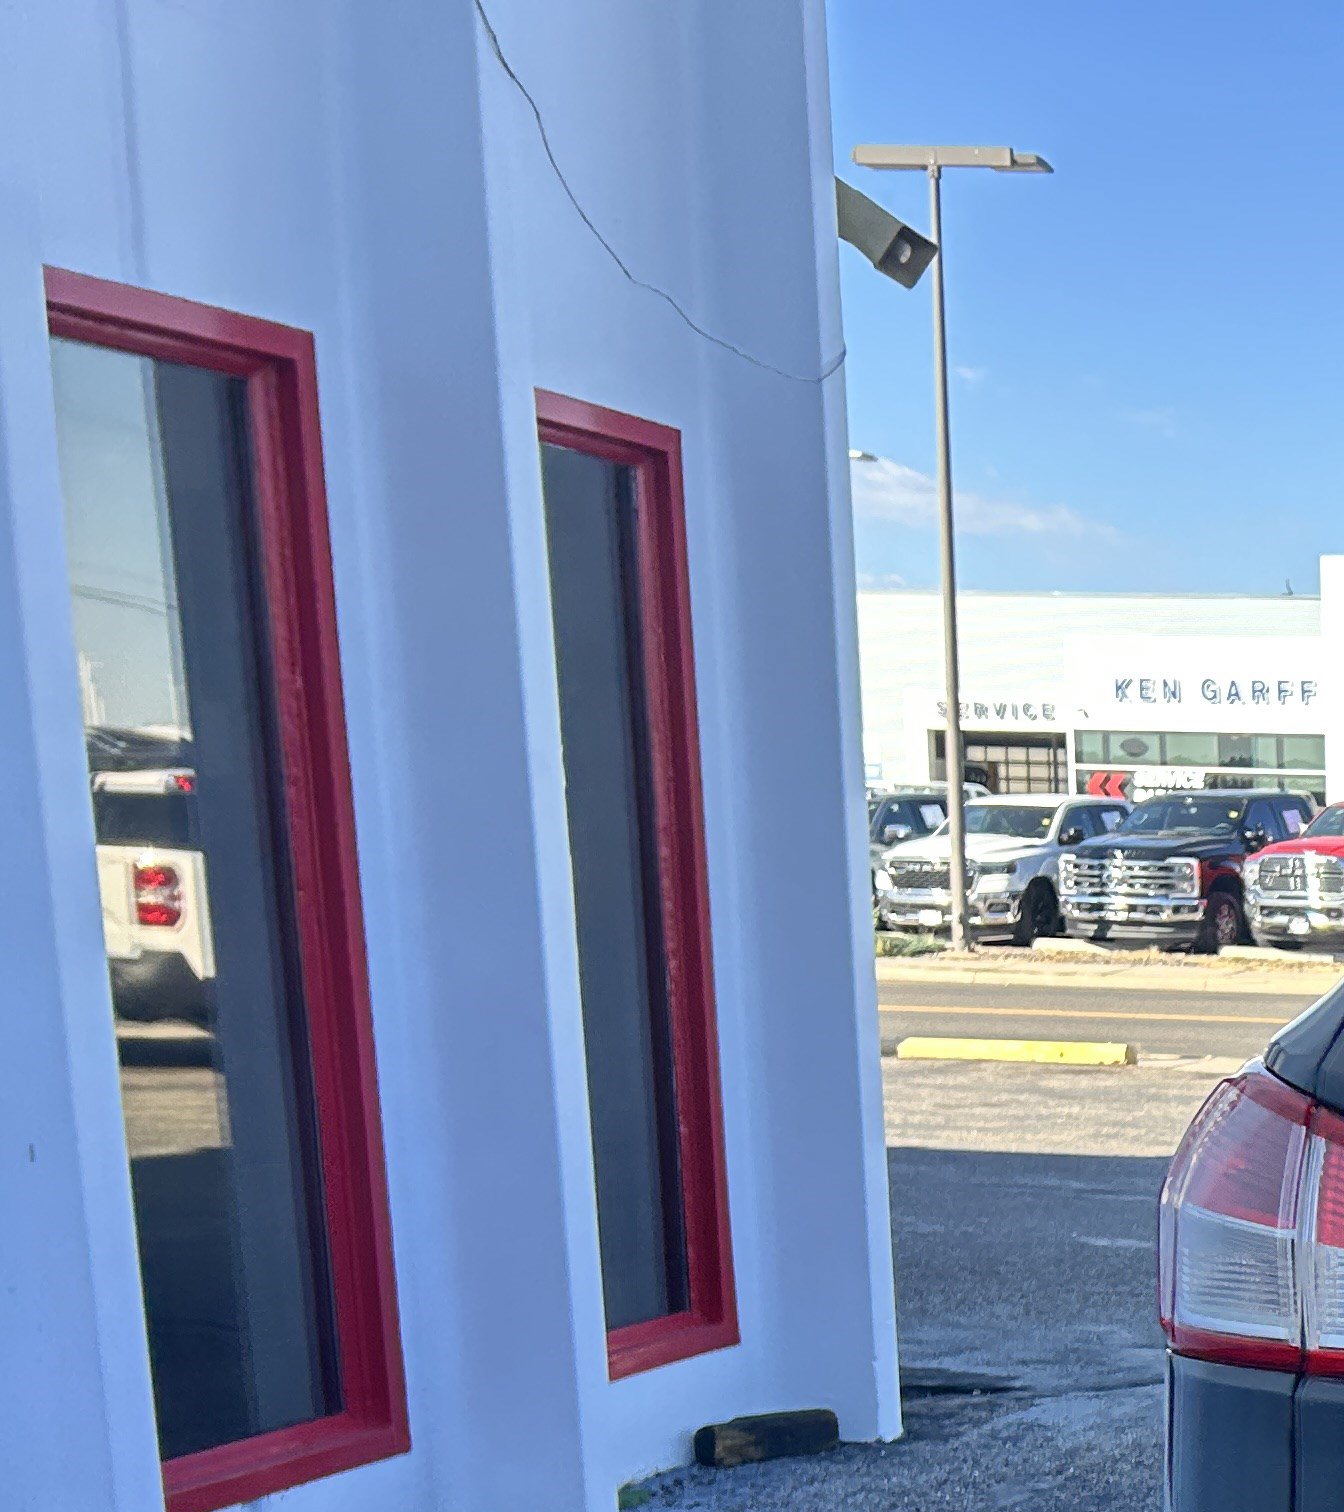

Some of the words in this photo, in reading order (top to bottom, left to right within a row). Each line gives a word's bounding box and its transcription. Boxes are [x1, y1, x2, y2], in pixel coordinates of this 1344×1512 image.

[1115, 679, 1182, 703] KEN
[1202, 679, 1317, 705] GARFF
[936, 702, 1056, 721] SERVICE
